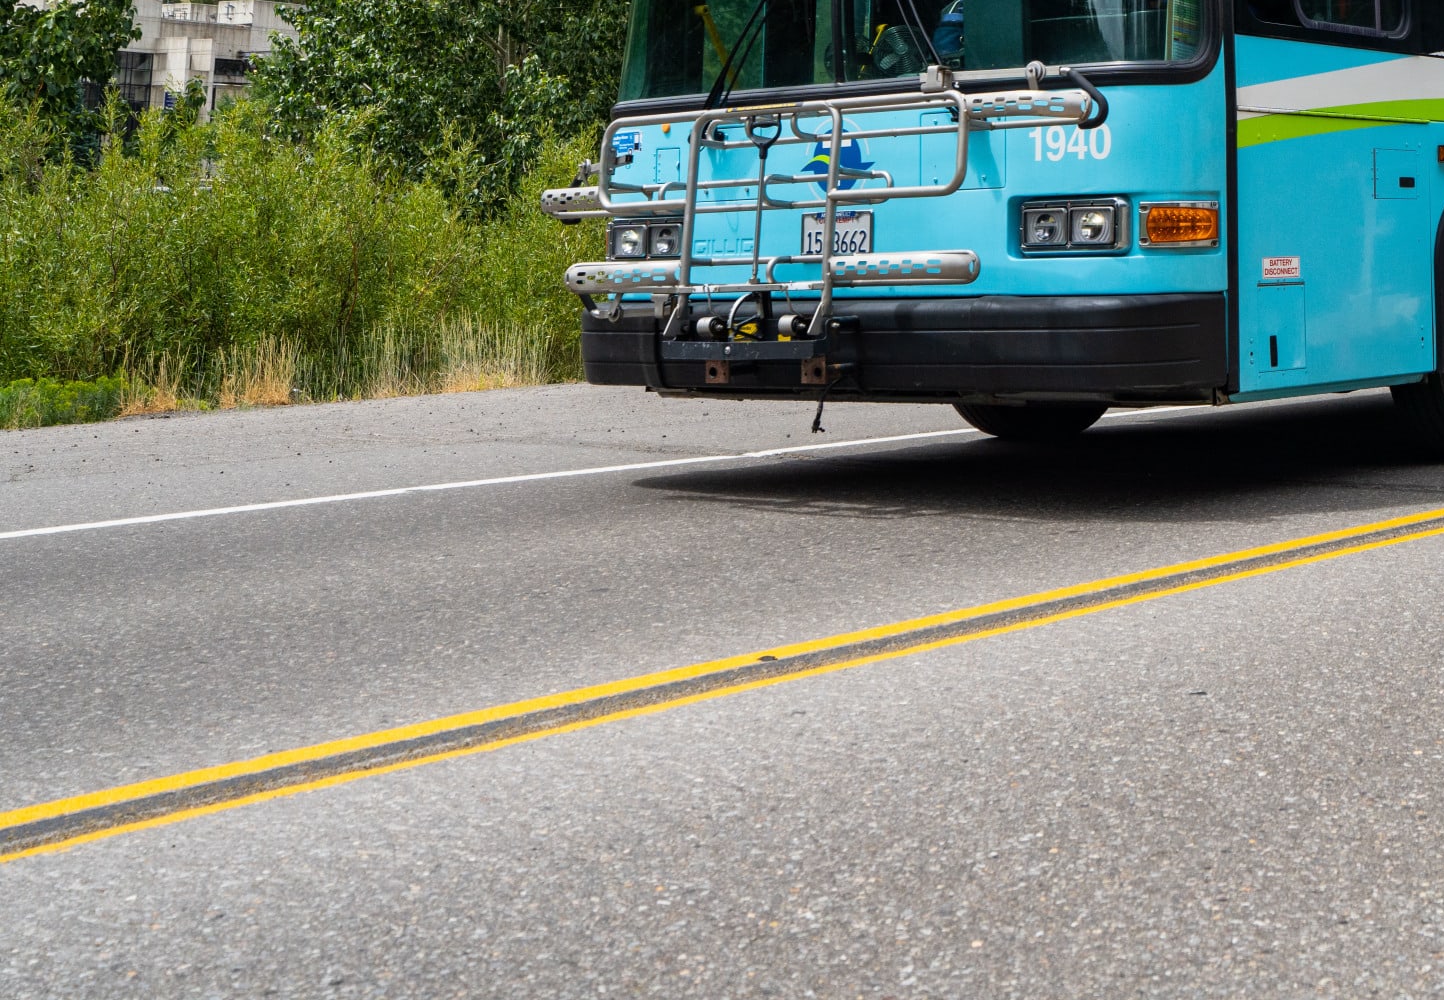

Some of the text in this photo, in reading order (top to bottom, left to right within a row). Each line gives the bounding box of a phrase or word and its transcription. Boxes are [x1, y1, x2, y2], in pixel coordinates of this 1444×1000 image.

[1029, 122, 1112, 162] 1940
[693, 238, 754, 257] GILLIG
[806, 230, 867, 254] 153662
[1264, 267, 1298, 275] DISCONNECT
[1269, 259, 1293, 267] BATTERY
